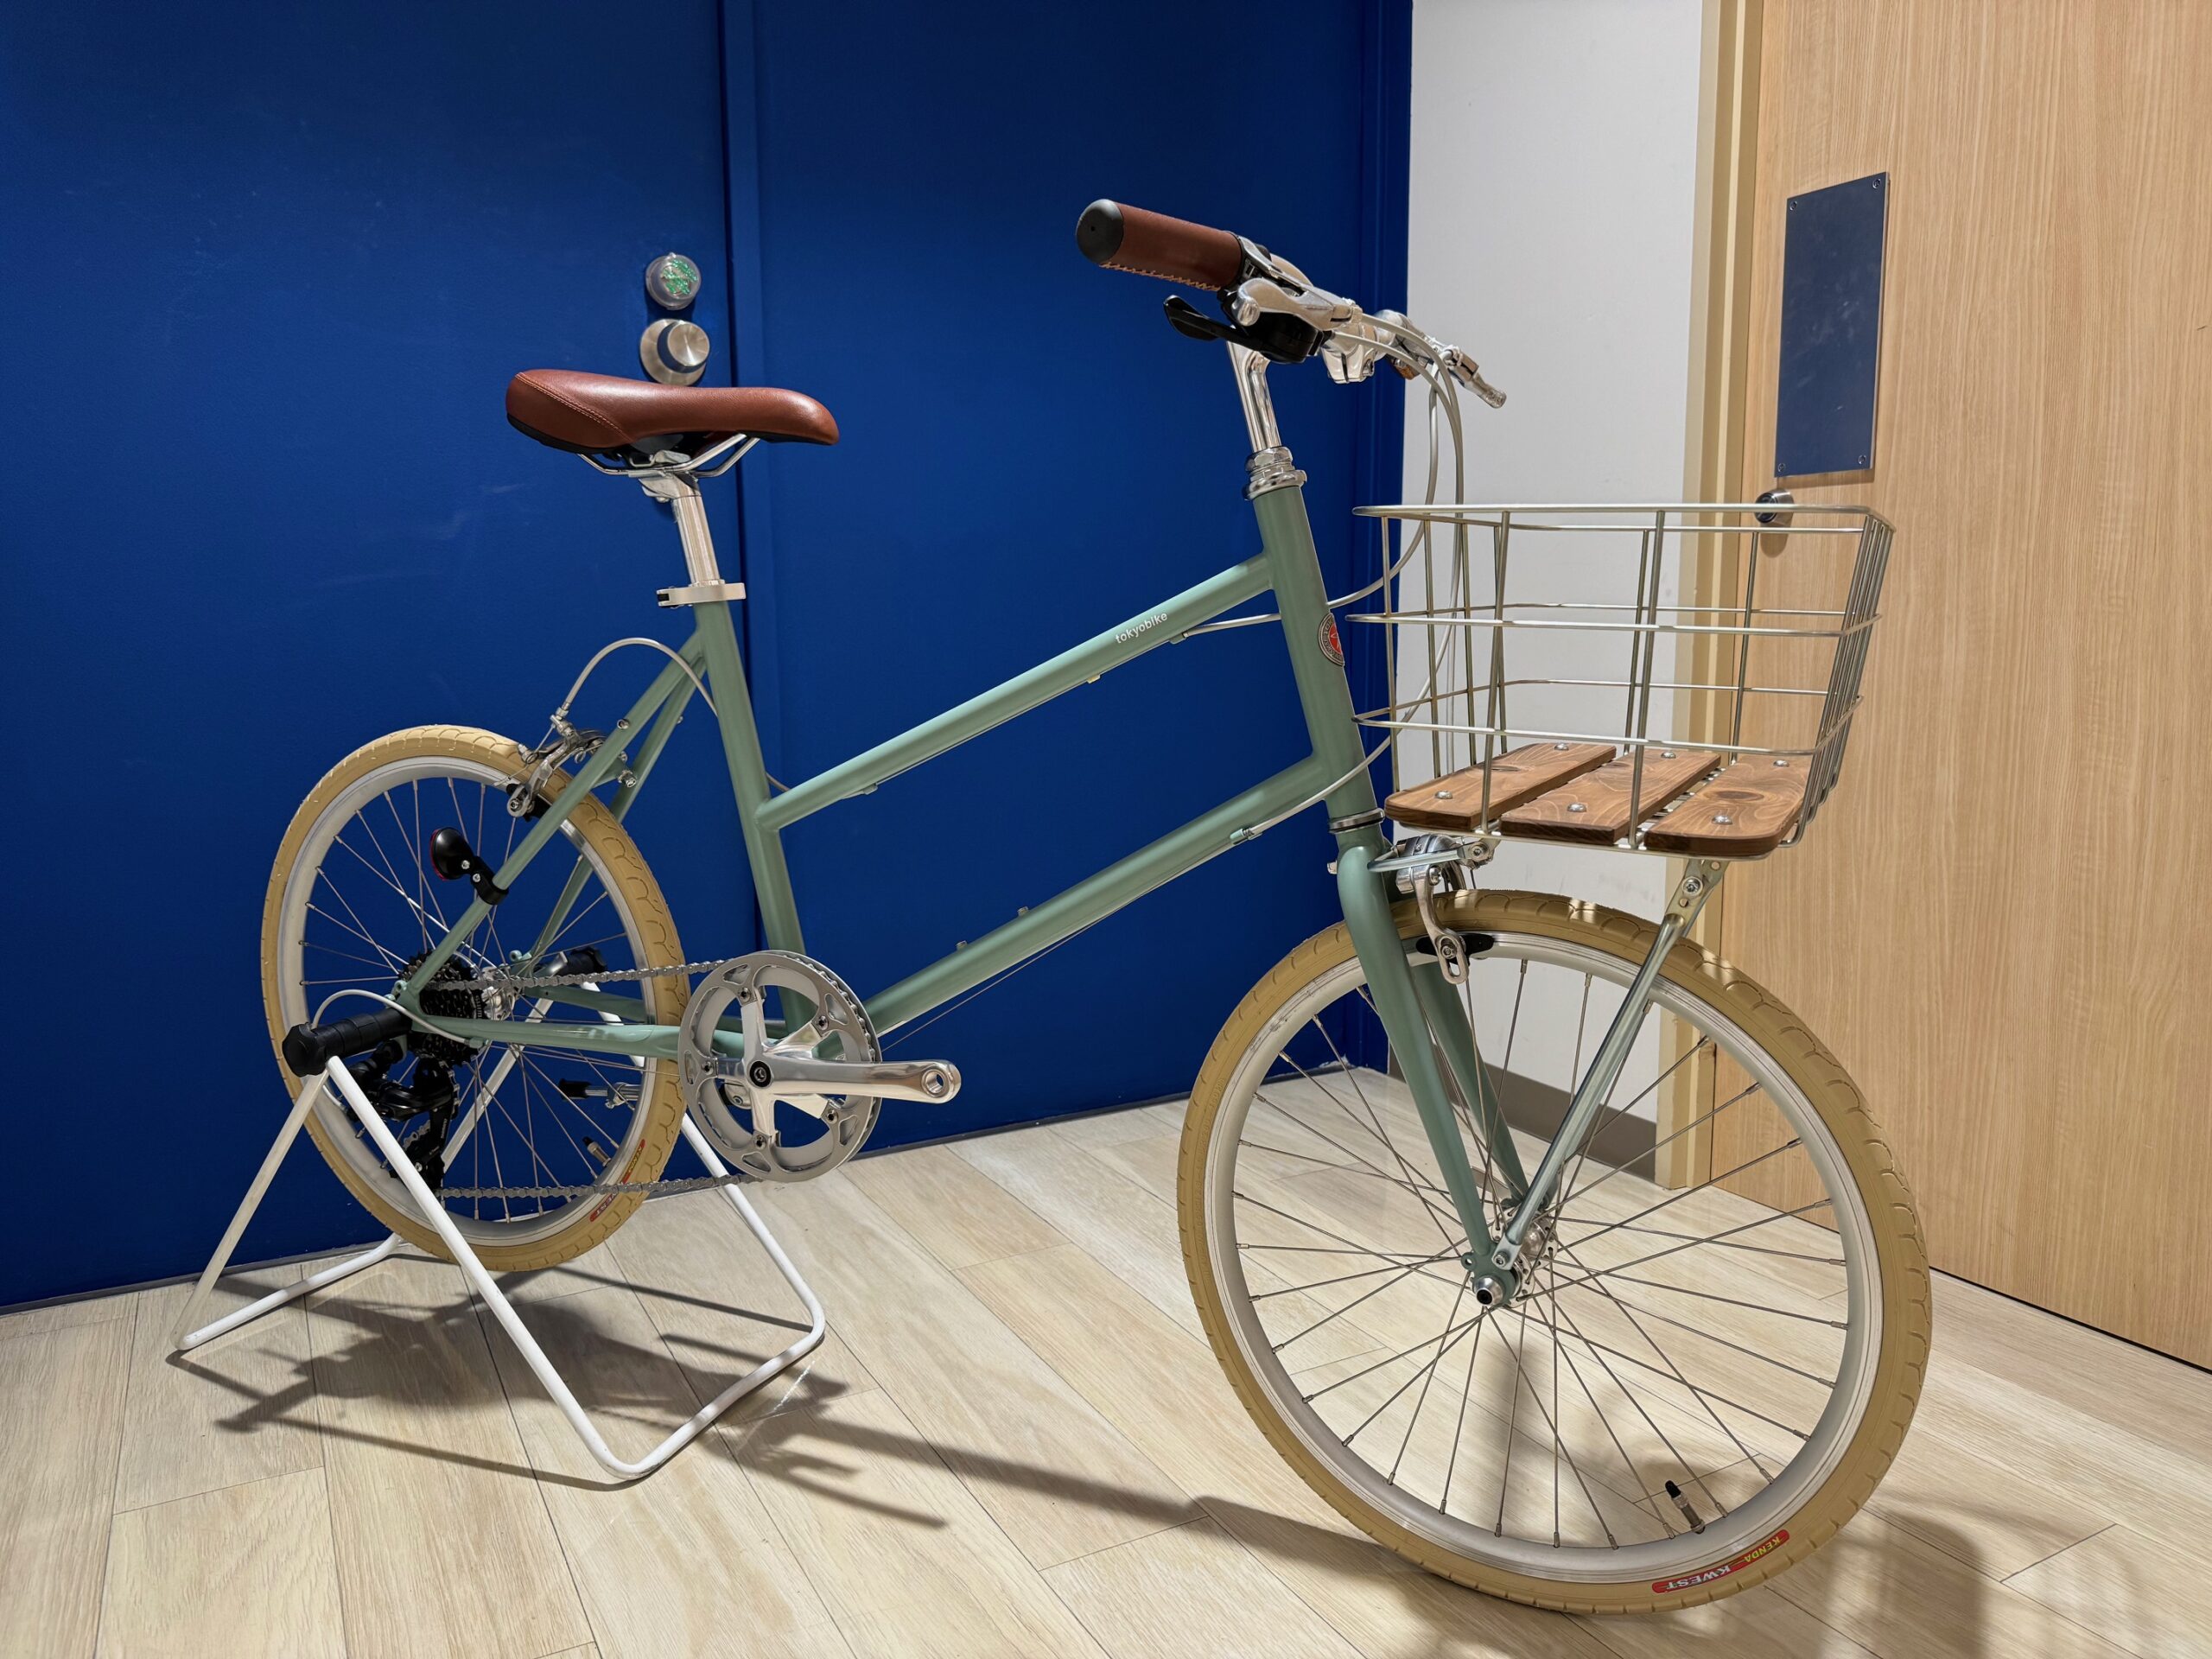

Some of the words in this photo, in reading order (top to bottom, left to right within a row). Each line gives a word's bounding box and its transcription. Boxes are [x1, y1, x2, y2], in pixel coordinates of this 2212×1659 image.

[1115, 613, 1168, 644] tokyobike
[1744, 1535, 1781, 1563] KENDA
[1666, 1565, 1732, 1591] KWEST
